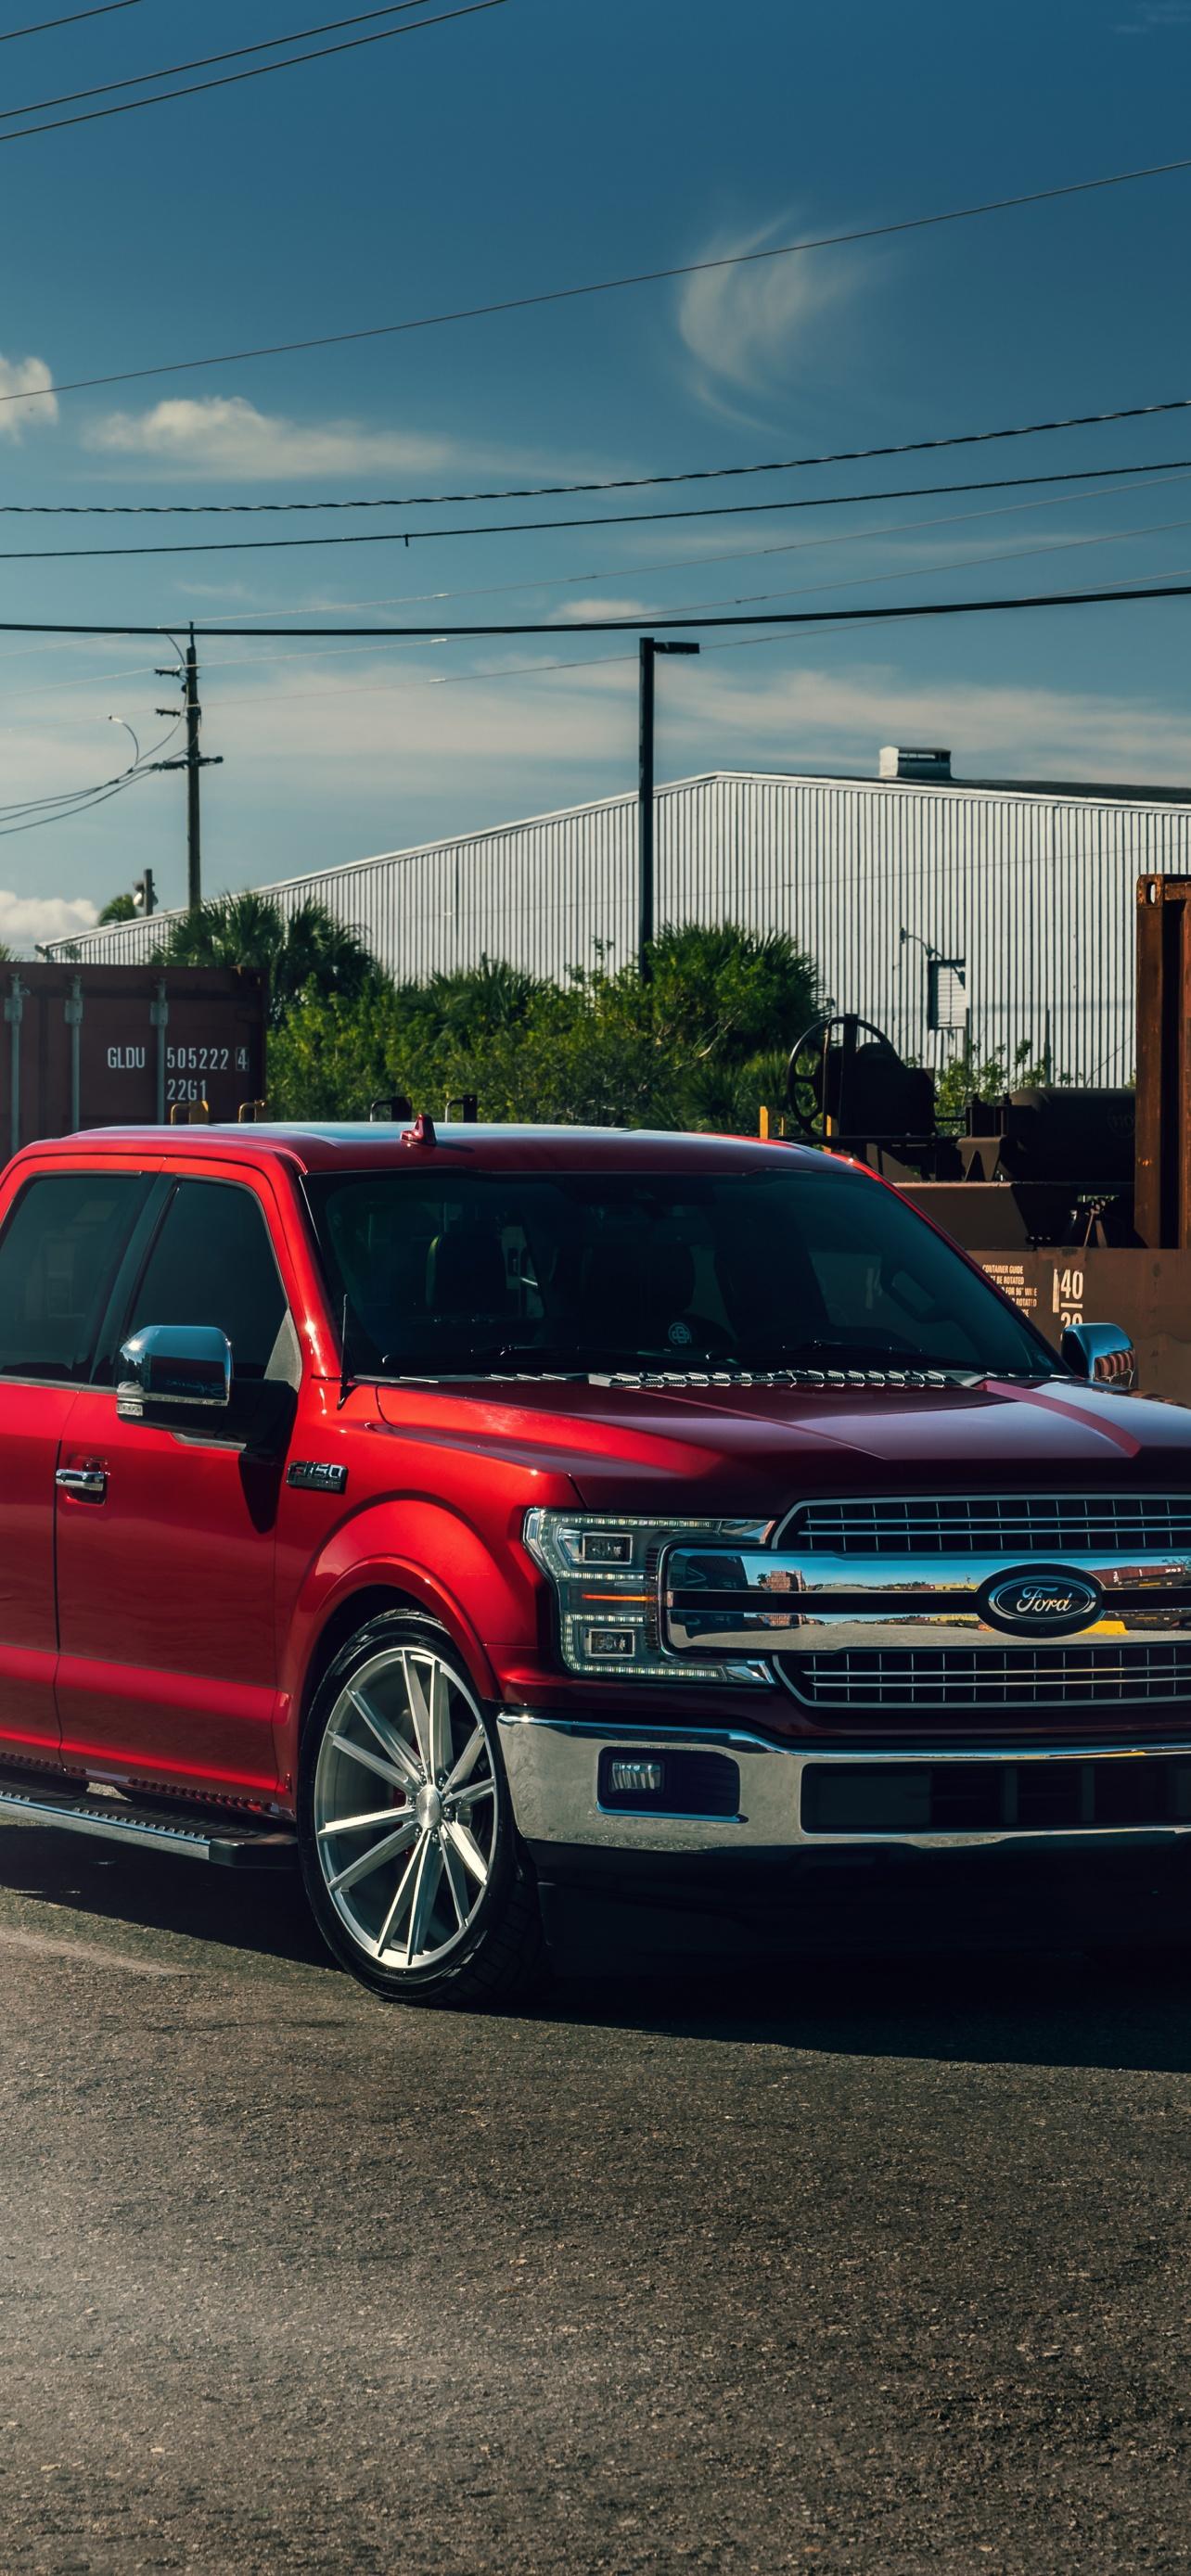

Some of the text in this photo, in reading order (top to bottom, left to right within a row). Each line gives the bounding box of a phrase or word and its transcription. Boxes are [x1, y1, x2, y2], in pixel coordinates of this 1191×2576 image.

[107, 1047, 249, 1070] GLDU 505222 4
[166, 1079, 207, 1101] 22G1
[1004, 1276, 1025, 1285] ROTATED
[1060, 1269, 1083, 1300] 40
[1025, 1287, 1038, 1297] WIE
[1016, 1586, 1072, 1613] Ford
